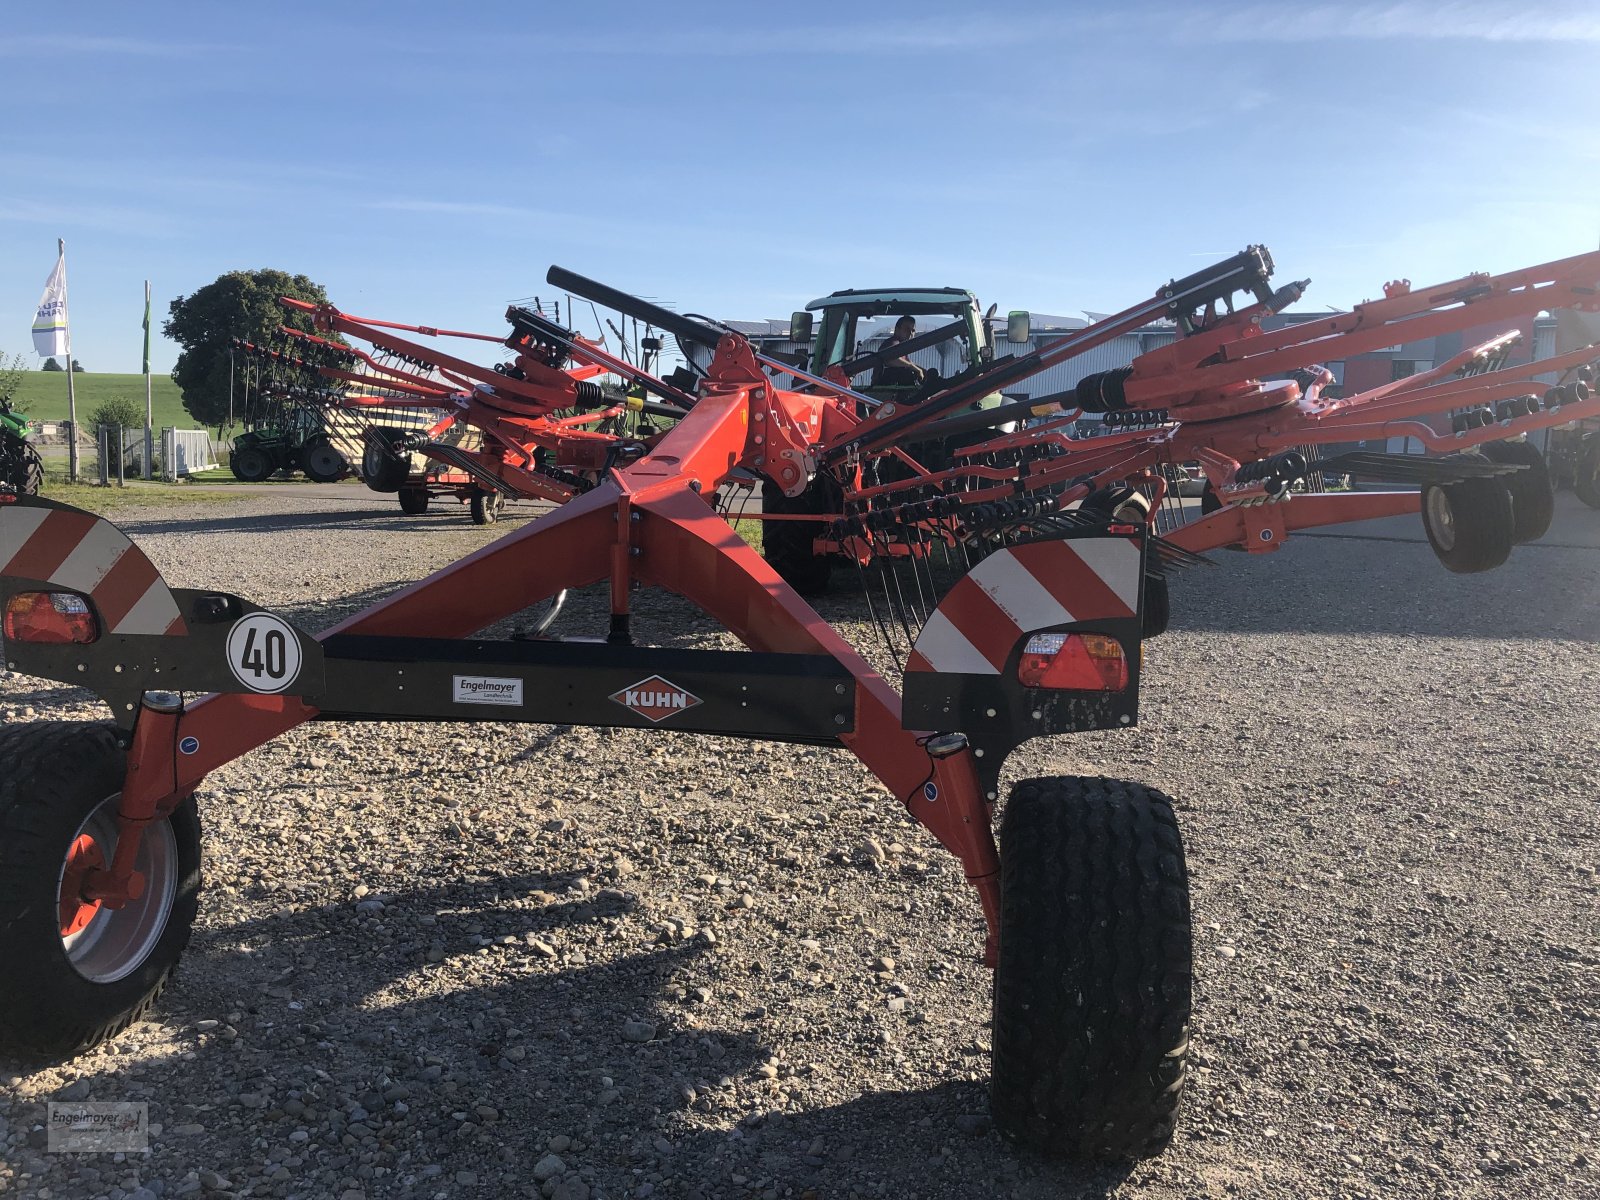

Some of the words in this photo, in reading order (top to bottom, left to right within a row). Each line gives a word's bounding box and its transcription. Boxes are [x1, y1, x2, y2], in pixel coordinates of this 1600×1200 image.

[241, 627, 286, 679] 40
[460, 679, 517, 694] Engelmayer
[625, 690, 687, 709] KUHN
